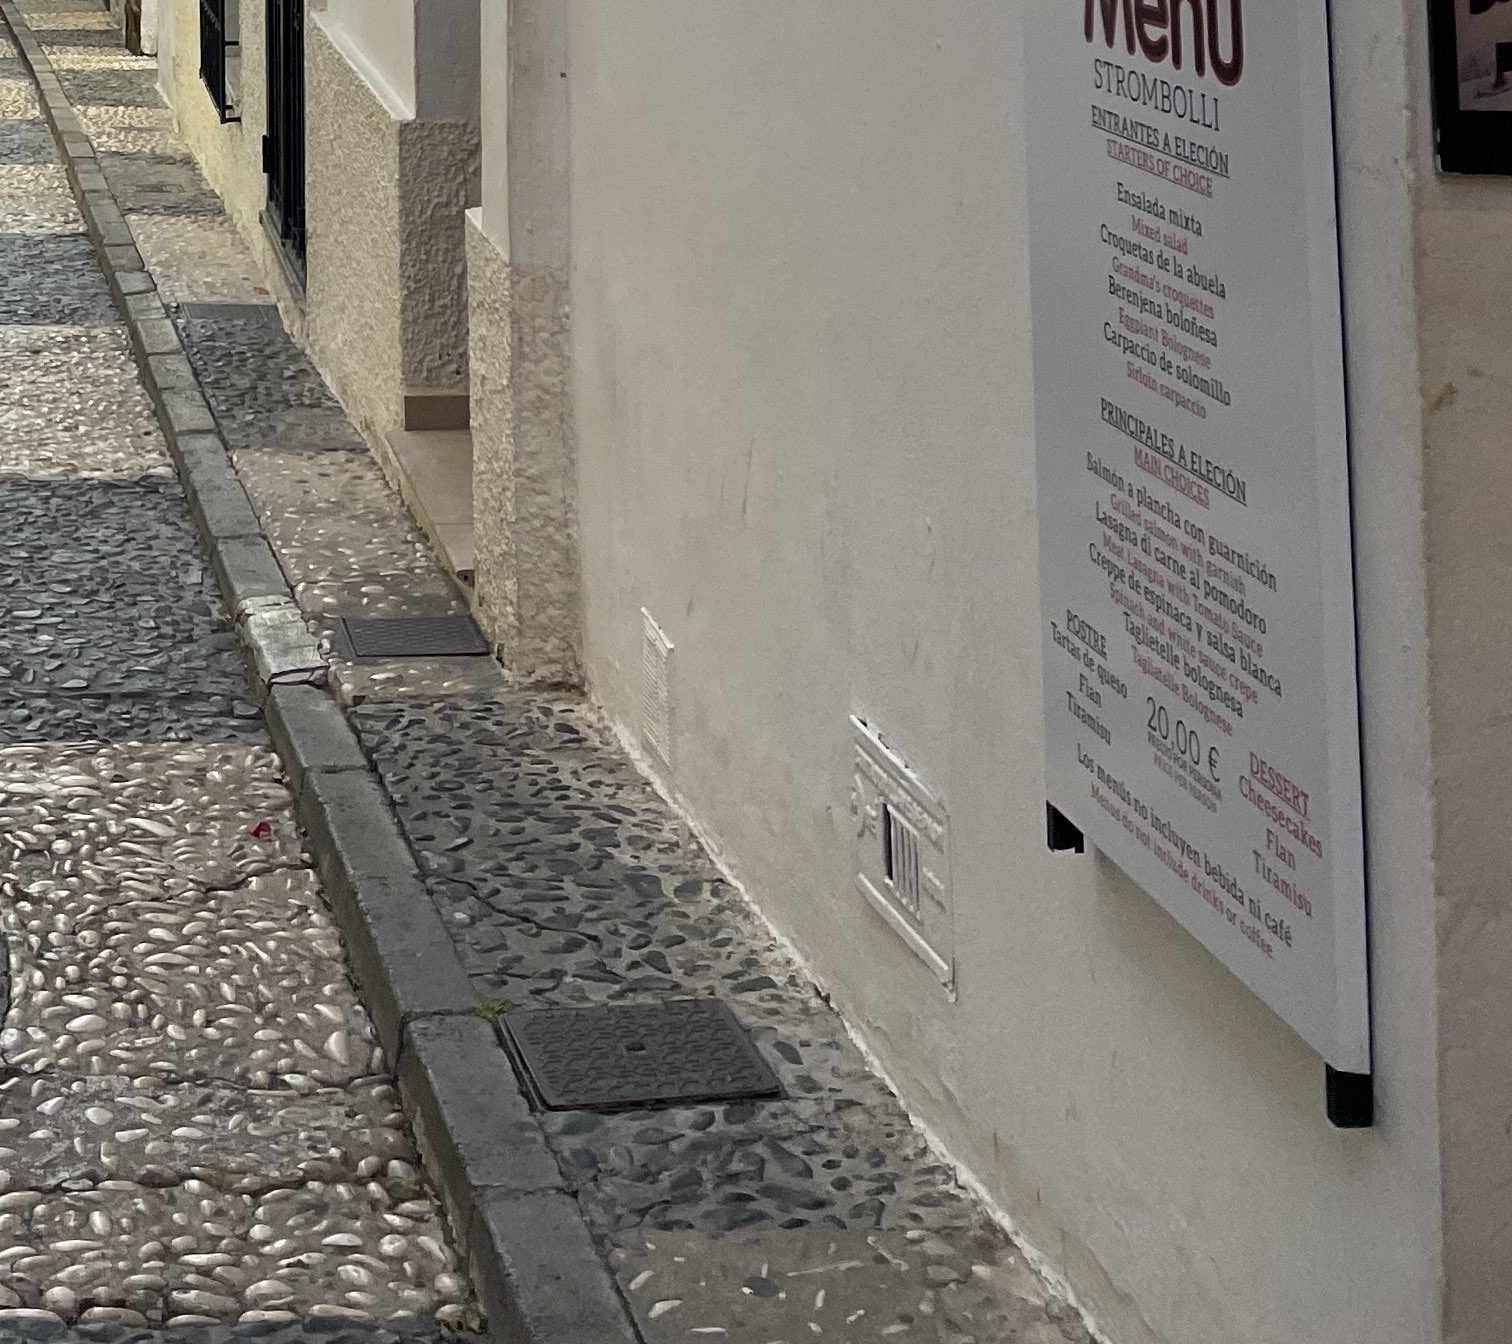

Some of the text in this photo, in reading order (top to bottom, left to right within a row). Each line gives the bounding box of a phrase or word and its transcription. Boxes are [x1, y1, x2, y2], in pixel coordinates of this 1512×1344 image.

[1094, 58, 1220, 131] STROMBOLLI
[1091, 104, 1229, 174] ENTRANTES A ELECIÓN
[1107, 138, 1212, 194] STARTERS OF CHOICE
[1117, 182, 1202, 236] Ensalada mixta
[1132, 214, 1188, 255] Mixed salad
[1101, 223, 1226, 299] Croquetas de la abuela
[1108, 275, 1217, 347] Berenjena boloñesa
[1119, 307, 1158, 342] Eggplant
[1163, 285, 1214, 319] croquettes
[1104, 322, 1231, 406] Carpaccio de solomillo
[1128, 361, 1206, 419] Sirloin carpaccio
[1100, 397, 1247, 503] PRINCIPALES A ELECIÓN
[1135, 445, 1210, 508] MAIN CHOICES
[1087, 451, 1277, 593] Salmón a plancha con guarnición
[1096, 501, 1266, 634] Lasagna di carne al pomodoro
[1180, 542, 1204, 567] with
[1206, 560, 1247, 597] garnish
[1066, 608, 1107, 657] POSTRE
[1089, 542, 1283, 698] Creppe de espinaca y salsa blanca
[1167, 579, 1191, 606] with
[1192, 593, 1229, 633] Tomato
[1231, 621, 1263, 657] Sauce
[1050, 621, 1128, 699] Tartas de queso
[1079, 673, 1103, 709] Flan
[1183, 653, 1244, 718] bolognesa
[1066, 690, 1111, 746] Tiramisu
[1147, 696, 1221, 782] 20,00 €
[1239, 775, 1323, 858] Cheesecakes
[1250, 751, 1309, 817] DESSERT
[1077, 743, 1095, 774] Los
[1133, 797, 1148, 820] no
[1150, 807, 1201, 868] incluyen
[1203, 851, 1245, 906] bebida
[1248, 896, 1262, 921] ni
[1264, 912, 1292, 948] café
[1266, 828, 1296, 871] Flan
[1252, 849, 1313, 918] Tiramisu
